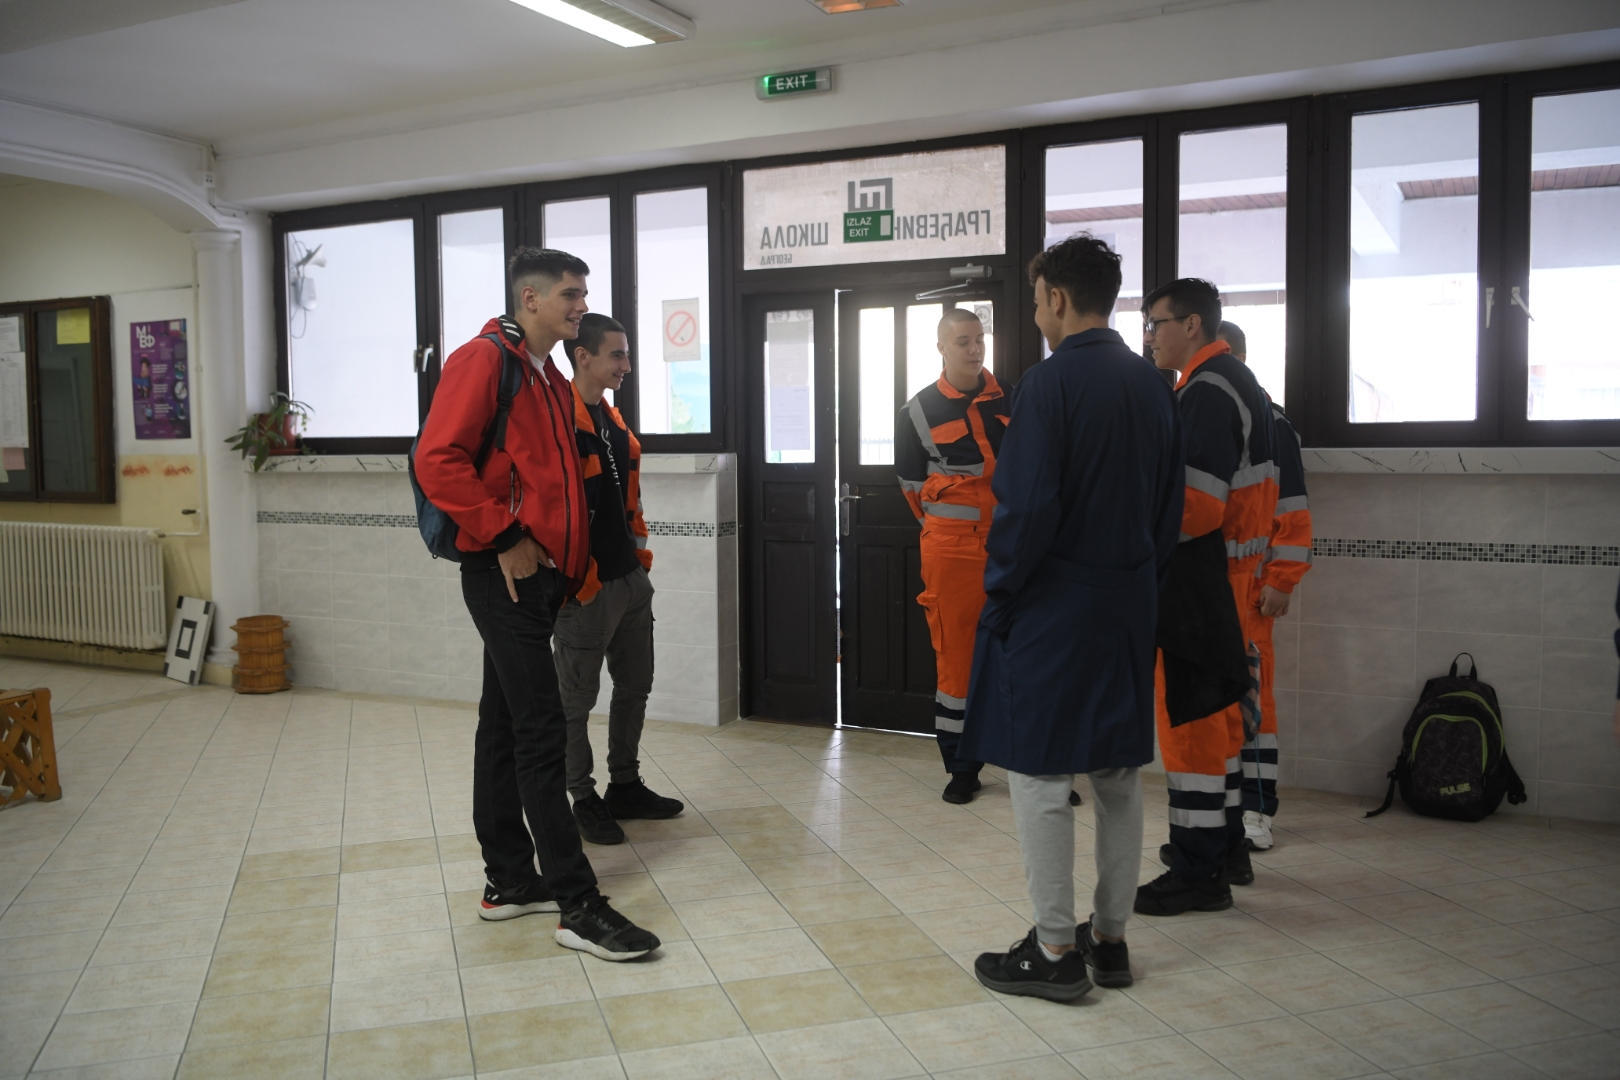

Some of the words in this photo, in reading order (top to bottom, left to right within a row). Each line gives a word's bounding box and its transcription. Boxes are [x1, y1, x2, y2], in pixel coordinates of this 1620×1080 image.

[776, 74, 808, 91] EXIT
[846, 216, 872, 227] IZLAZ
[849, 228, 870, 237] EXIT
[1439, 783, 1471, 795] PULSE
